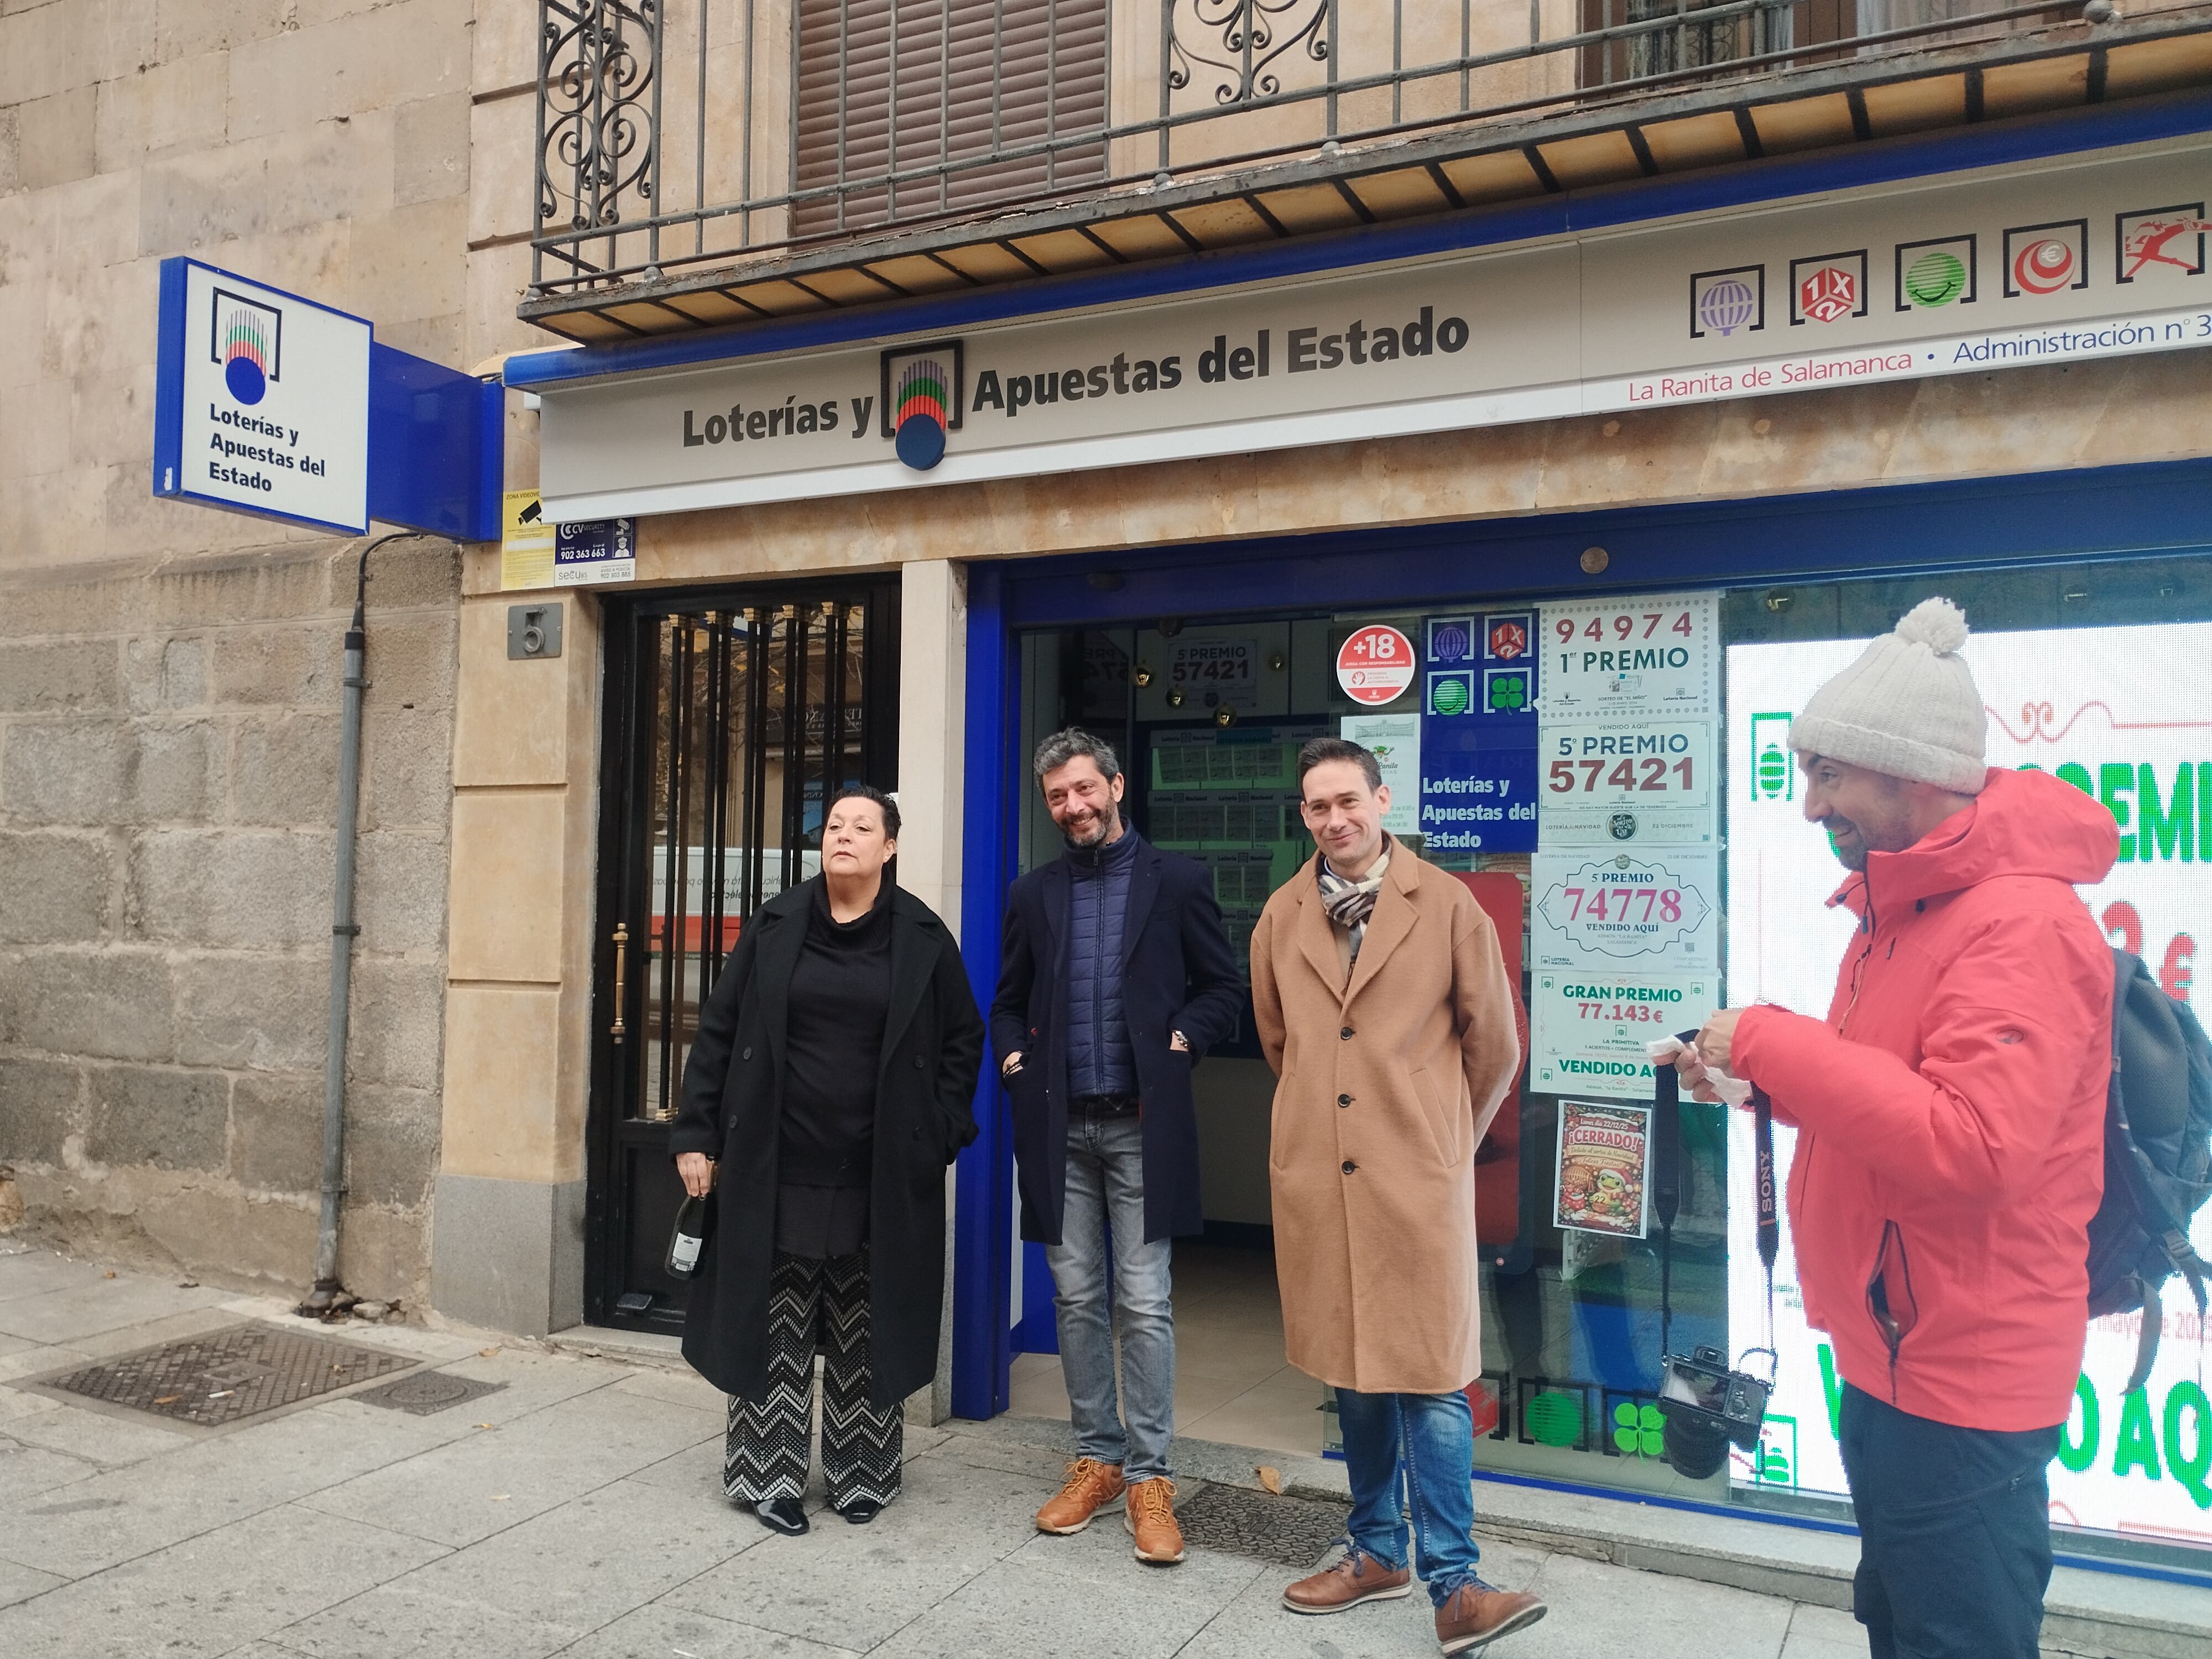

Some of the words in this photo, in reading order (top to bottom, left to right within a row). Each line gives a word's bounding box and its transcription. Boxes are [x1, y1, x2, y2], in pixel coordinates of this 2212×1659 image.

[1630, 383, 1653, 401] La
[1662, 372, 1733, 398] Ranita
[1741, 366, 1772, 388] de
[1781, 353, 1912, 385] Salamanca
[1953, 322, 2154, 364] Administración
[684, 395, 838, 447] Loterías
[852, 395, 874, 439] y
[972, 352, 1181, 418] Apuestas
[1198, 329, 1270, 383] del
[1288, 305, 1469, 373] Estado
[211, 403, 284, 439] Loterías
[289, 429, 299, 447] y
[210, 432, 294, 468] Apuestas
[300, 456, 325, 477] del
[210, 461, 272, 492] Estado
[561, 551, 574, 560] 902
[576, 550, 589, 559] 363
[591, 548, 605, 557] 663
[1556, 612, 1692, 644] 94974
[1190, 646, 1246, 659] PREMIO
[1353, 634, 1395, 659] +18
[1172, 659, 1248, 681] 57421
[1584, 647, 1689, 672] PREMIO
[1583, 734, 1688, 755] PREMIO
[1548, 757, 1693, 793] 57421
[1423, 776, 1493, 794] Loterías
[1499, 780, 1510, 797] y
[1422, 804, 1503, 825] Apuestas
[1508, 802, 1536, 820] del
[1423, 831, 1481, 848] Estado
[1602, 873, 1653, 883] PREMIO
[1563, 888, 1682, 922] 74778
[1586, 923, 1630, 931] VENDIDO
[1633, 922, 1659, 932] AQUÍ
[1563, 985, 1611, 1000] GRAN
[1616, 987, 1682, 1003] PREMIO
[1559, 1060, 1636, 1076] VENDIDO
[1640, 1065, 1656, 1077] A
[1604, 1121, 1628, 1129] 22/12/25
[1569, 1130, 1638, 1151] ¡CERRADO!
[1760, 1150, 1771, 1212] SONY
[1594, 1195, 1605, 1203] 22
